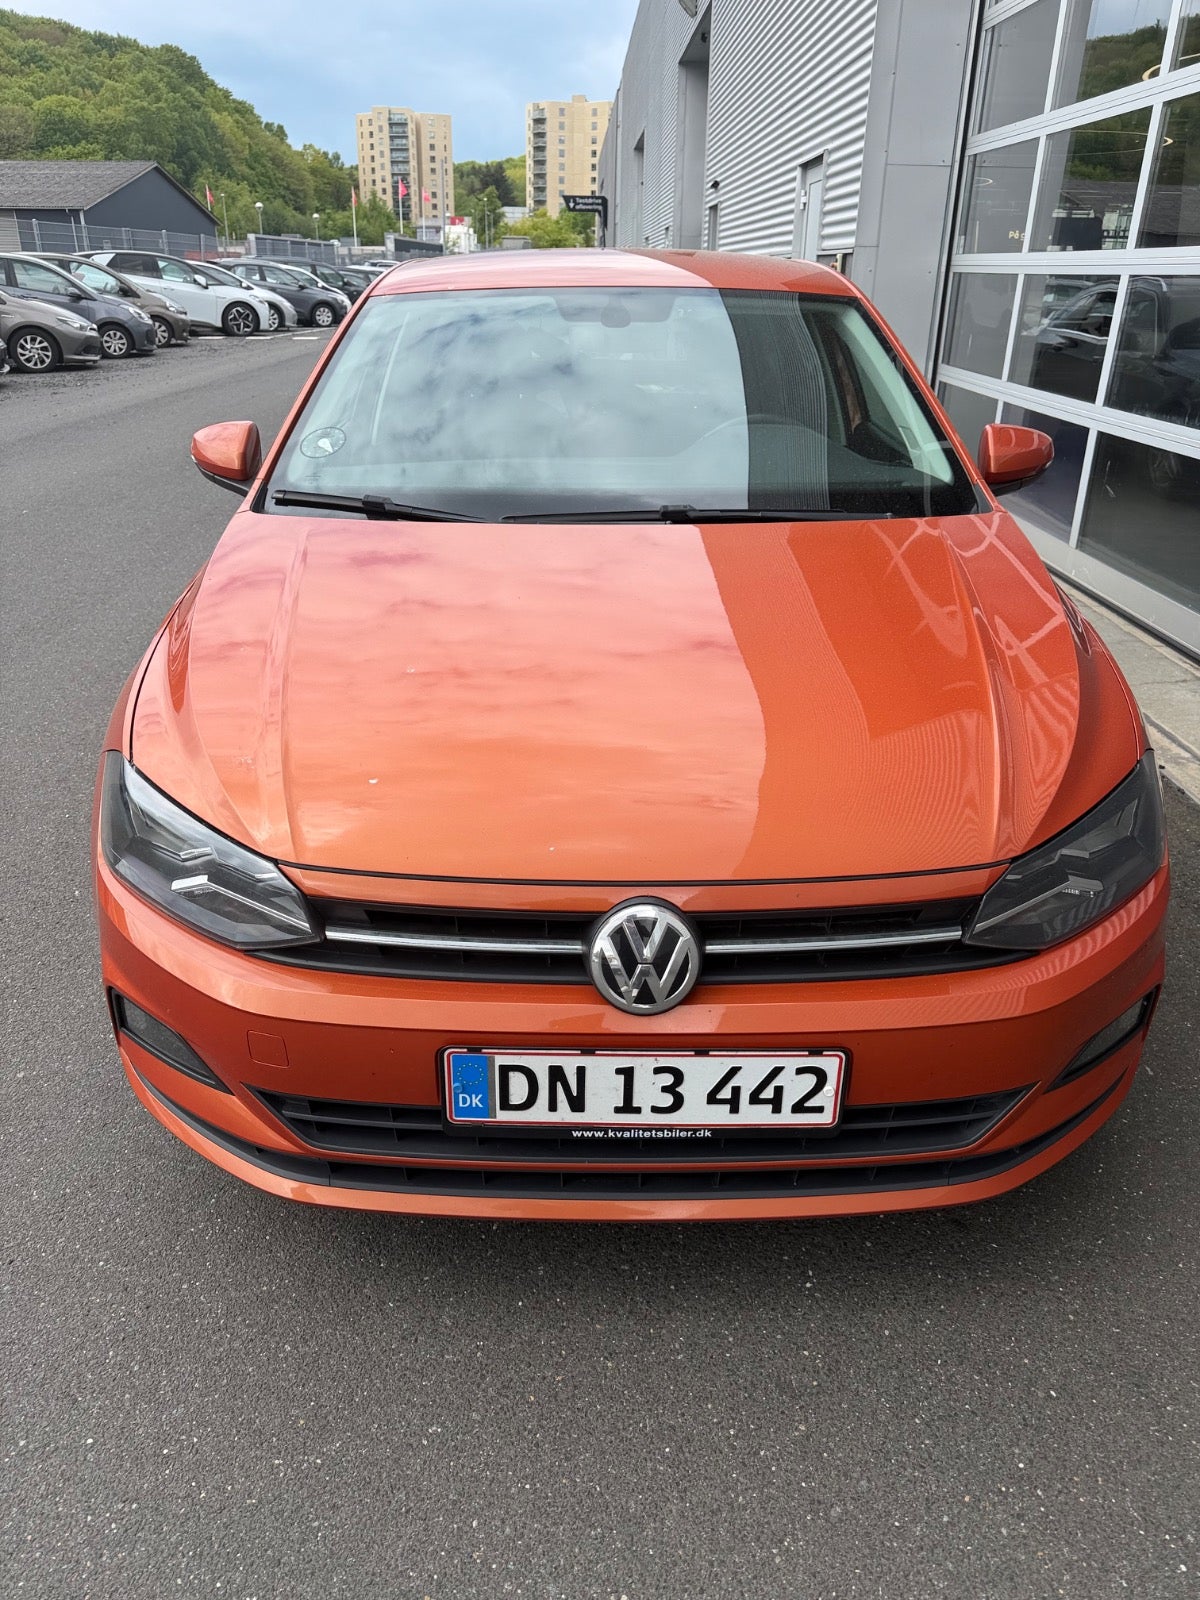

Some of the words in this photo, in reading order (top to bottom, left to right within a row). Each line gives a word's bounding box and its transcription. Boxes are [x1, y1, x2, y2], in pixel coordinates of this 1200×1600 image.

[597, 912, 693, 1008] VW
[458, 1093, 484, 1108] DK
[498, 1064, 586, 1113] DN
[614, 1066, 685, 1114] 13
[706, 1065, 828, 1114] 442
[571, 1128, 712, 1140] www.kvalitetsbiler.dk
